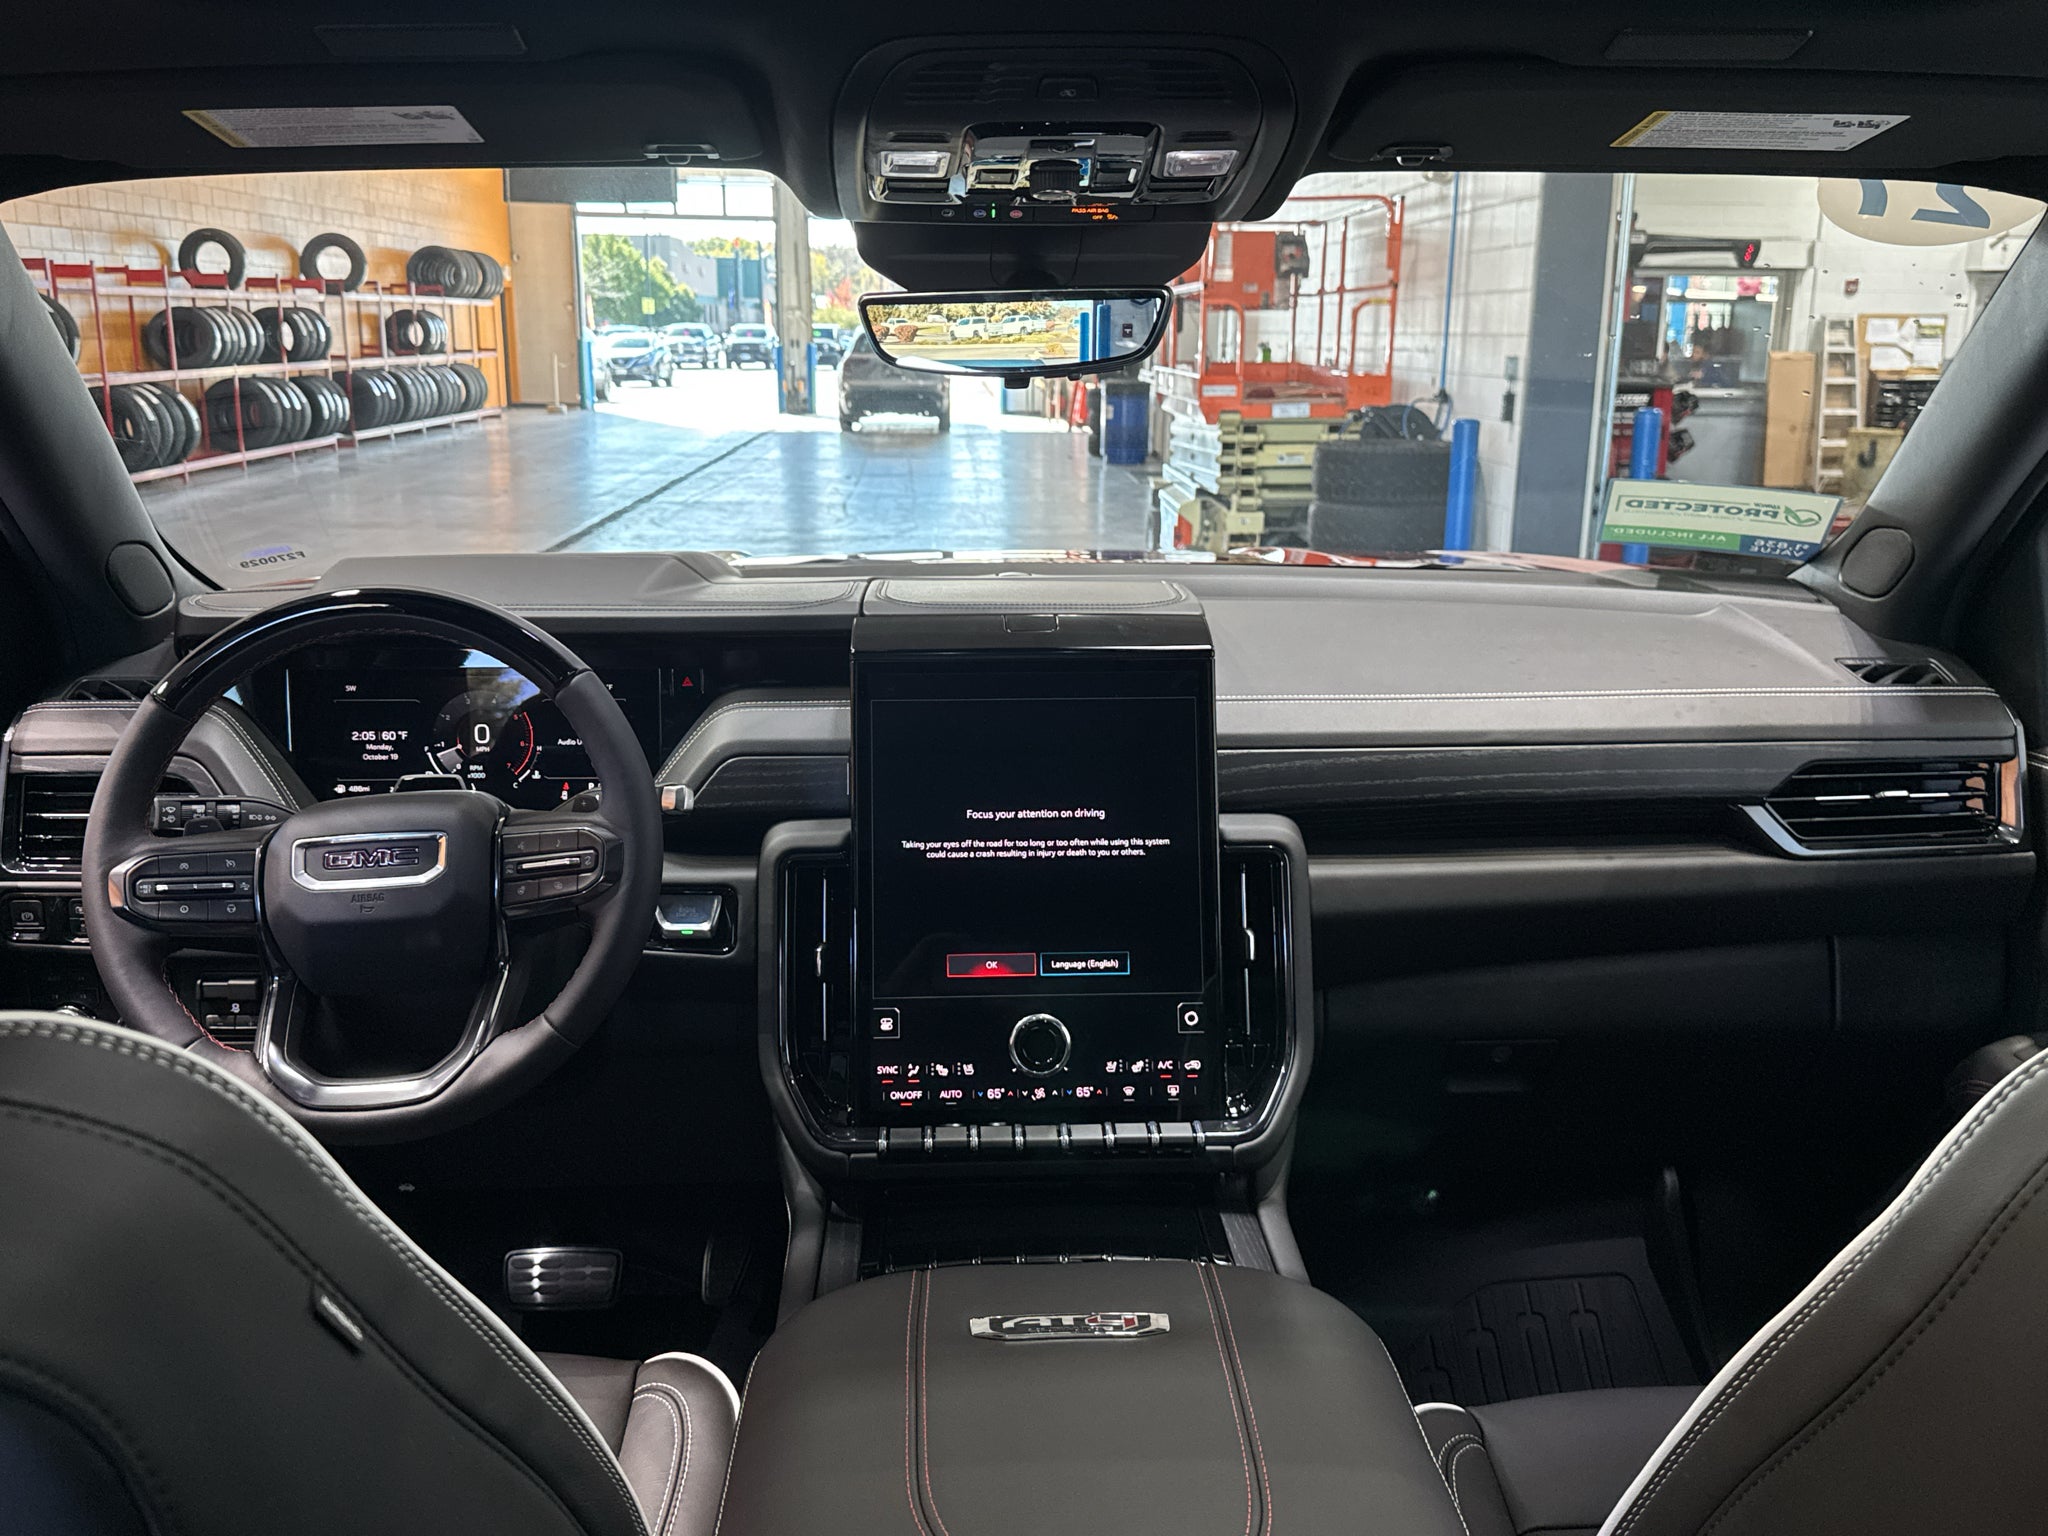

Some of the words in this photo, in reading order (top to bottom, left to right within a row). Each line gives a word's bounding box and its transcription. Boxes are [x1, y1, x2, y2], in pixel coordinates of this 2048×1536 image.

[351, 731, 376, 741] 2:05
[381, 731, 397, 741] 60
[474, 724, 490, 743] 0
[557, 738, 576, 746] Audio
[966, 809, 994, 819] Focus
[995, 811, 1016, 821] your
[1017, 809, 1059, 819] attention
[1060, 810, 1073, 818] on
[1074, 808, 1106, 820] driving
[901, 840, 925, 850] Taking
[926, 841, 942, 850] your
[943, 841, 960, 850] eyes
[960, 840, 972, 848] off
[973, 840, 985, 848] the
[986, 839, 1002, 848] road
[1004, 839, 1014, 847] for
[1029, 838, 1046, 848] long
[1069, 838, 1089, 846] often
[1090, 838, 1109, 846] while
[1110, 838, 1129, 848] using
[1130, 838, 1144, 846] this
[1144, 838, 1170, 848] system
[323, 847, 419, 870] GMC
[926, 850, 946, 858] could
[976, 850, 995, 858] crash
[996, 849, 1027, 859] resulting
[1036, 849, 1056, 858] injury
[1066, 848, 1087, 856] death
[1097, 849, 1110, 858] you
[1120, 848, 1146, 856] others.
[350, 892, 385, 904] AIRBAG
[985, 961, 998, 969] OK
[1051, 960, 1086, 970] Language
[1087, 959, 1119, 970] (English)
[1158, 1060, 1174, 1070] A/C
[876, 1066, 899, 1075] SYNC
[890, 1090, 922, 1100] ON/OFF
[940, 1090, 962, 1098] AUTO
